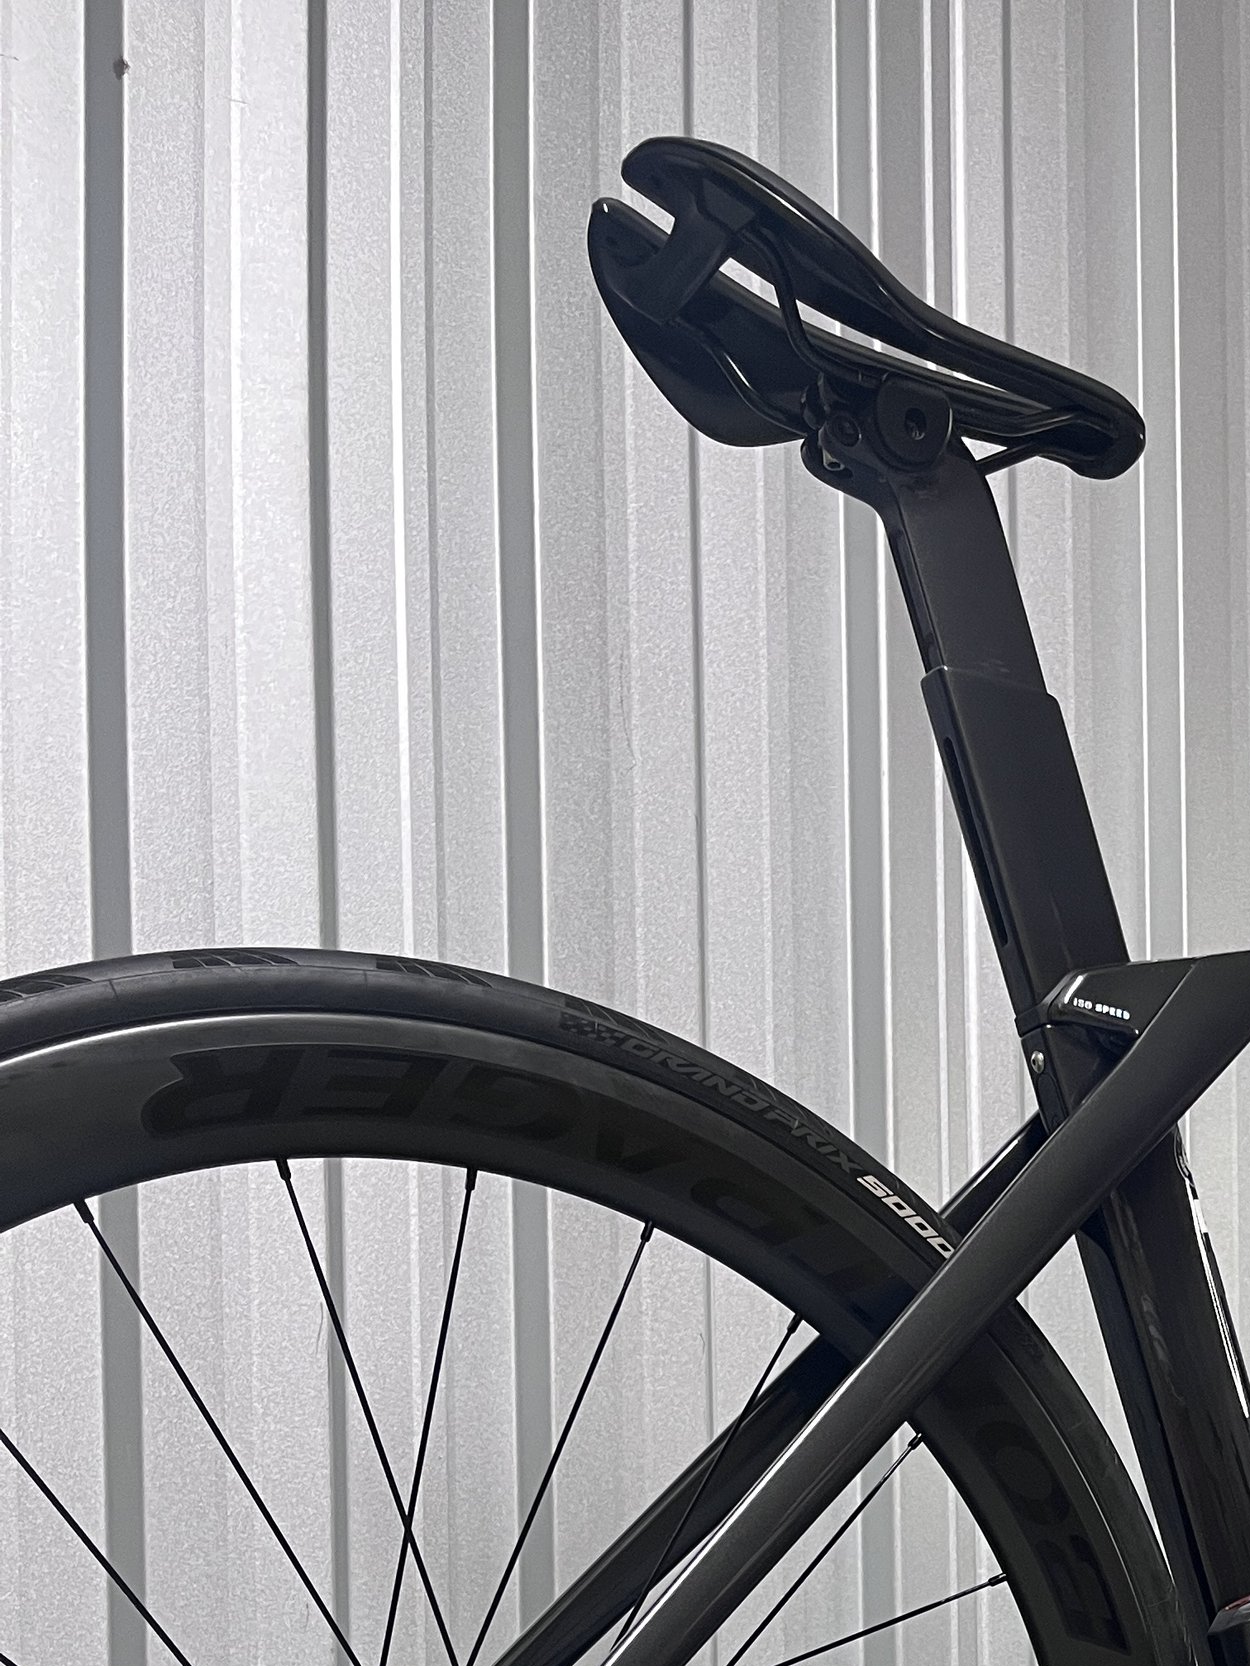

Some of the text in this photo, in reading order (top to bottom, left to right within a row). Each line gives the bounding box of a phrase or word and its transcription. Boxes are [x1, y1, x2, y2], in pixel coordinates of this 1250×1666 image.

[1073, 997, 1131, 1020] ISO SPEED
[623, 1034, 956, 1259] GRAND PRIX 5000
